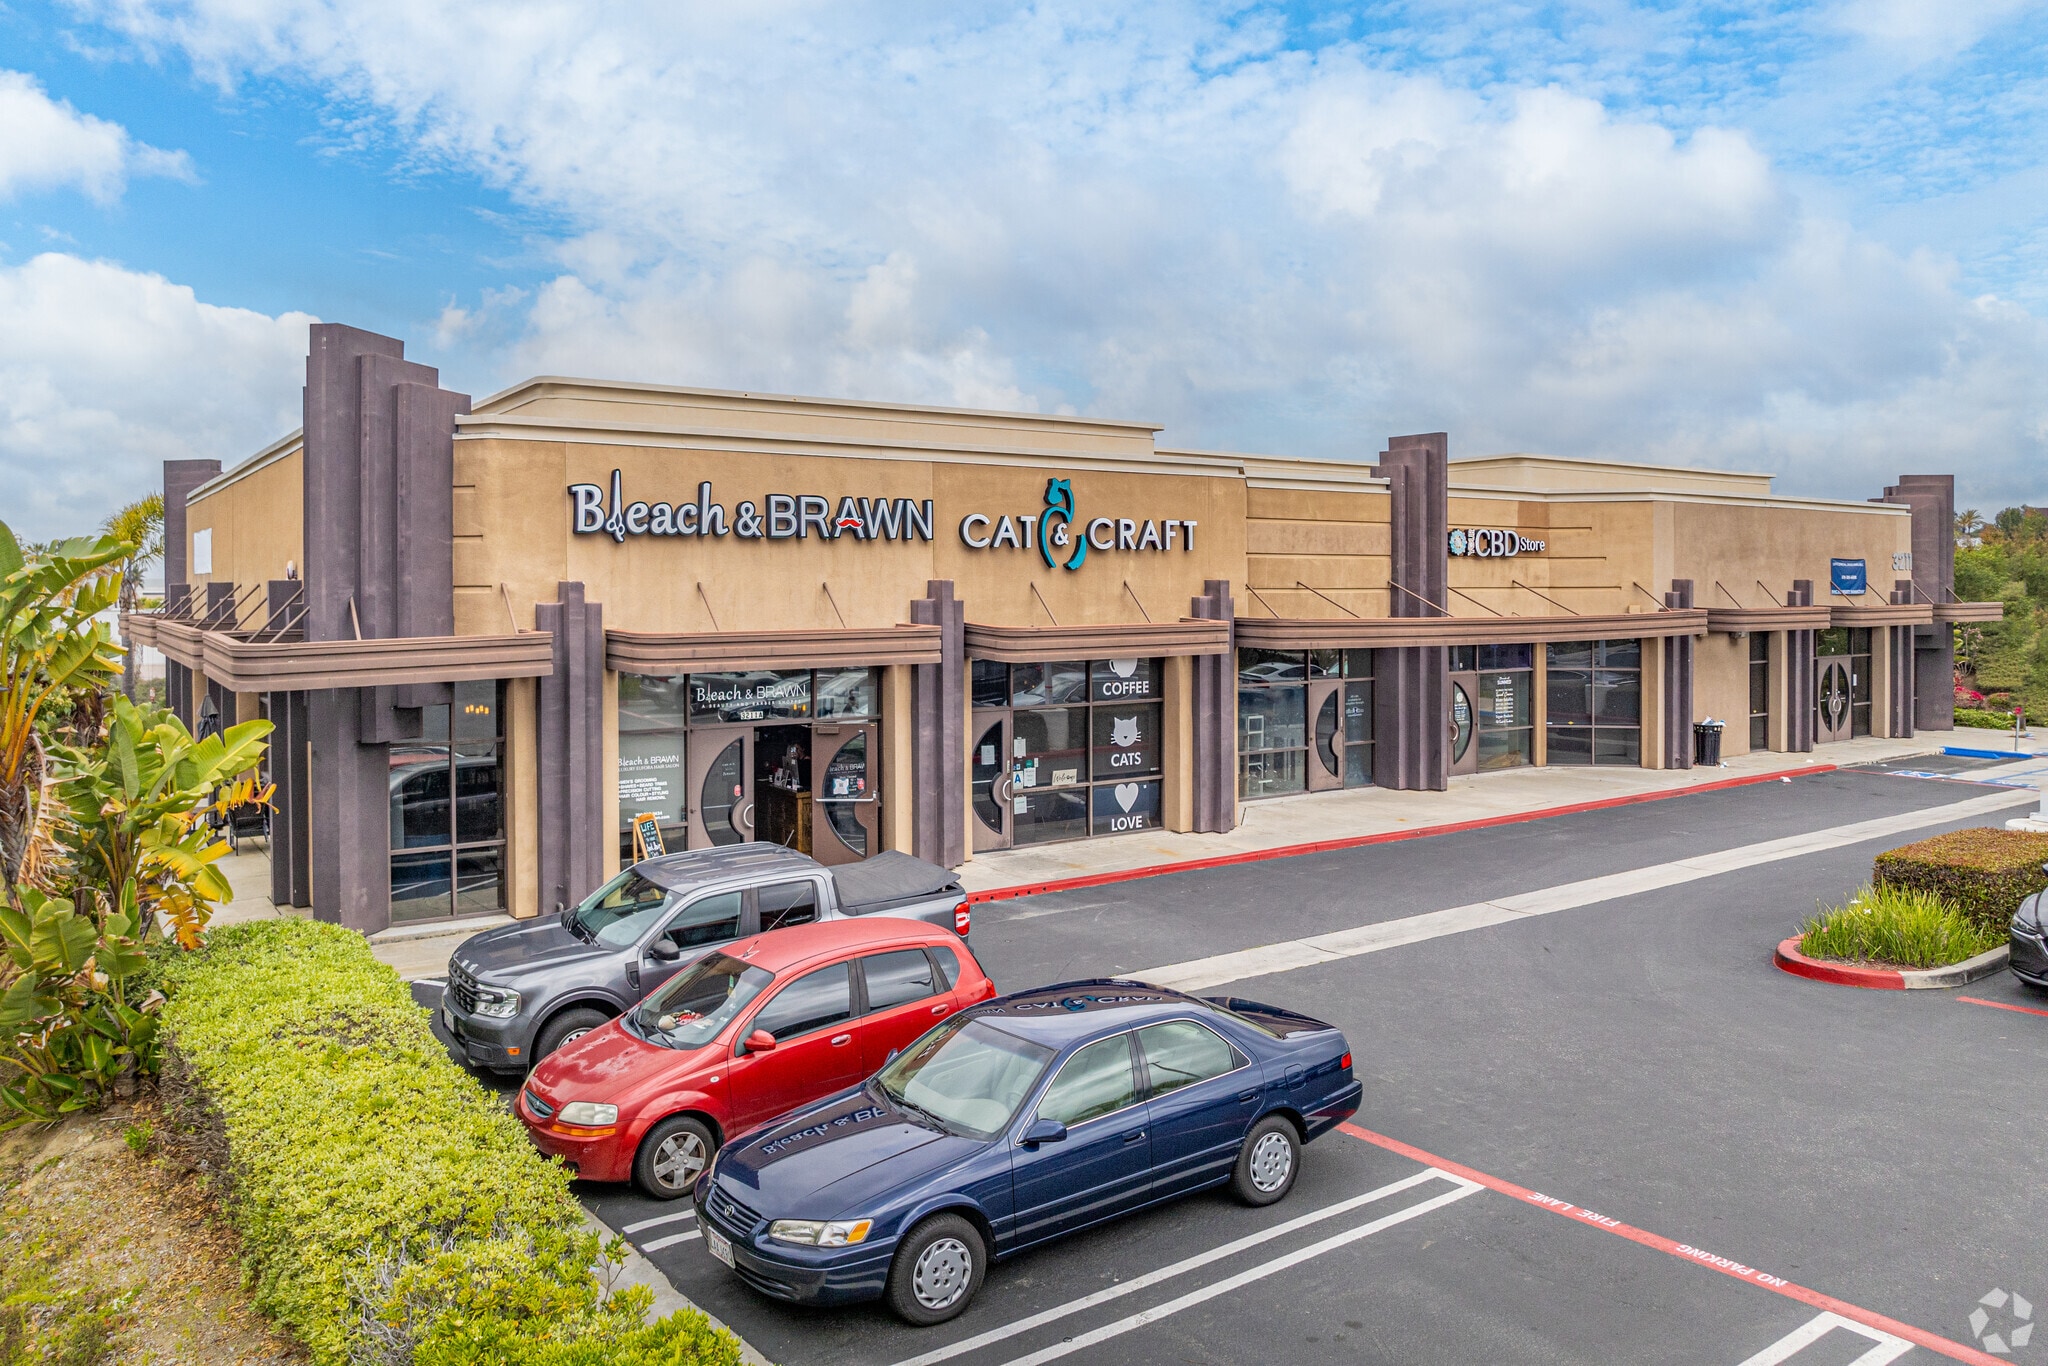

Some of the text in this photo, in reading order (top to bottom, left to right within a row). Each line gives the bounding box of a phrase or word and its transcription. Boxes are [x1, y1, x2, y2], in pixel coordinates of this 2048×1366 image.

[568, 469, 933, 543] Bleach & BRAWN
[959, 513, 1197, 551] CAT & CRAFT
[1475, 528, 1520, 557] CBD
[1520, 537, 1545, 551] Store
[1892, 552, 1912, 571] 3211
[696, 683, 806, 703] Bleach & BRAWN
[1103, 681, 1149, 695] COFFEE
[618, 756, 643, 767] Bleach
[650, 755, 679, 764] BRAWN
[1111, 752, 1142, 767] CATS
[1015, 774, 1021, 783] A
[640, 821, 655, 832] LIFE
[1111, 815, 1142, 831] LOVE
[1527, 1192, 1621, 1227] FIRE LANE
[1676, 1244, 1788, 1287] NO PARKING
